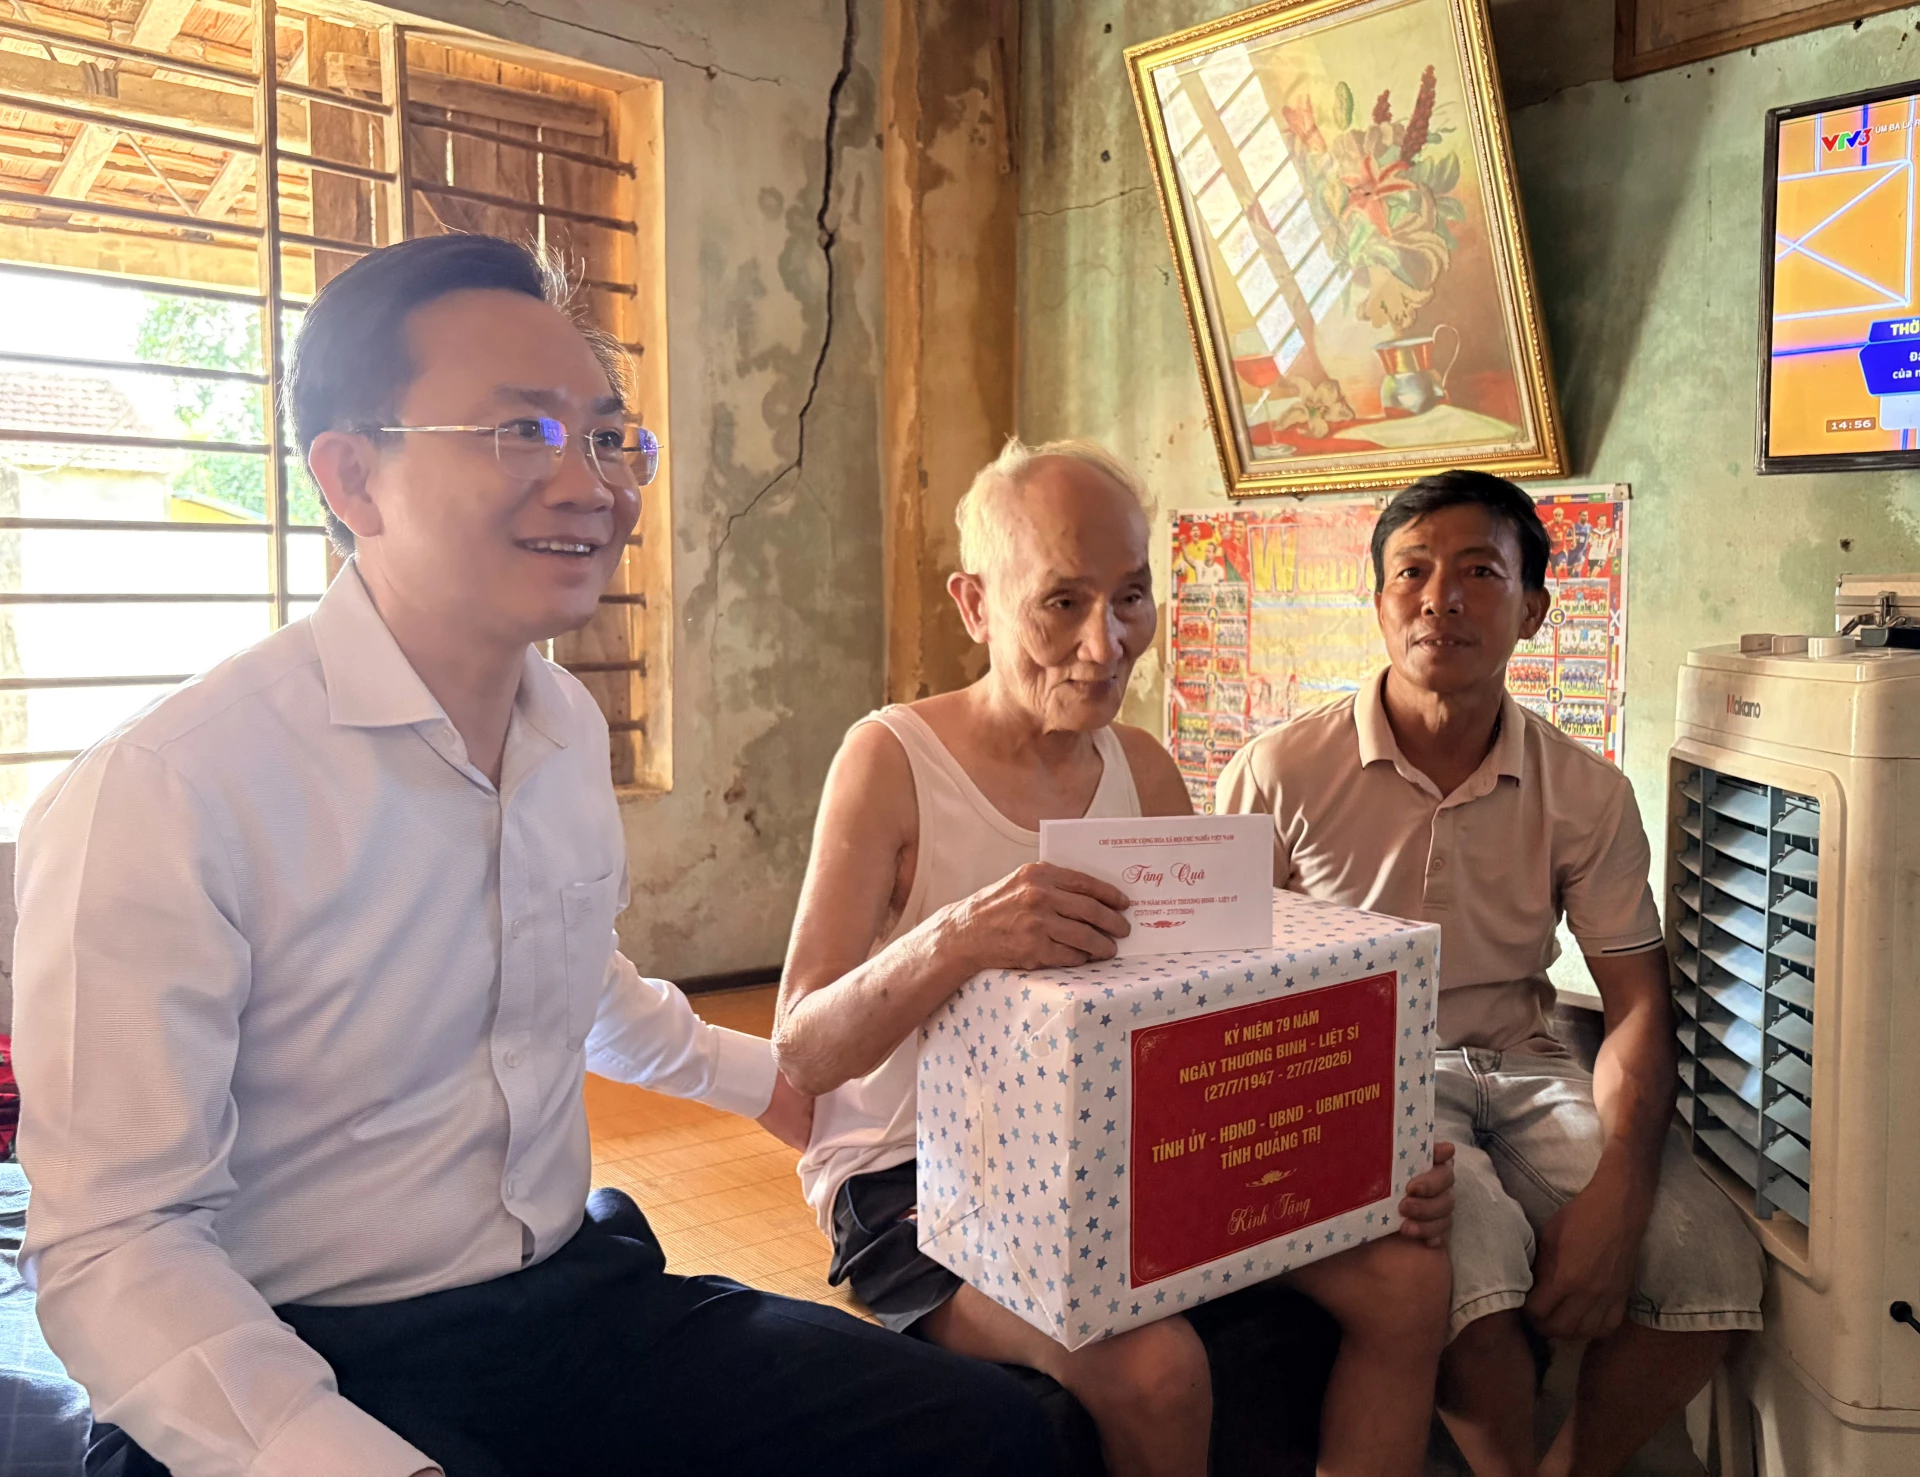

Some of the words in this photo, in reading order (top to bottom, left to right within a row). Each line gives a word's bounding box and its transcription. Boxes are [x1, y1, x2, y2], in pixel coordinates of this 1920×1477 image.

[1821, 127, 1873, 152] VTV3
[1892, 367, 1912, 379] của
[1831, 419, 1872, 430] 14:56
[1551, 611, 1562, 623] G
[1550, 690, 1560, 702] H
[1122, 864, 1164, 888] Tặng
[1224, 1023, 1239, 1046] KỶ
[1243, 1020, 1273, 1042] NIỆM
[1276, 1016, 1290, 1033] 79
[1293, 1009, 1319, 1028] NĂM
[1179, 1060, 1216, 1084] NGÀY
[1220, 1047, 1272, 1073] THƯƠNG
[1276, 1038, 1307, 1058] BINH
[1319, 1028, 1344, 1048] LIỆT
[1204, 1070, 1275, 1103] (27/7/1947
[1286, 1049, 1352, 1080] 27/7/2026)
[1152, 1137, 1185, 1163] TỈNH
[1188, 1128, 1206, 1153] ỦY
[1220, 1118, 1257, 1144] HĐND
[1269, 1105, 1304, 1129] UBND
[1316, 1083, 1381, 1115] UBMTTQVN
[1221, 1145, 1251, 1170] TỈNH
[1254, 1131, 1298, 1160] QUẢNG
[1302, 1125, 1321, 1144] TRỊ
[1227, 1204, 1270, 1236] Kính
[1273, 1192, 1311, 1220] Tặng
